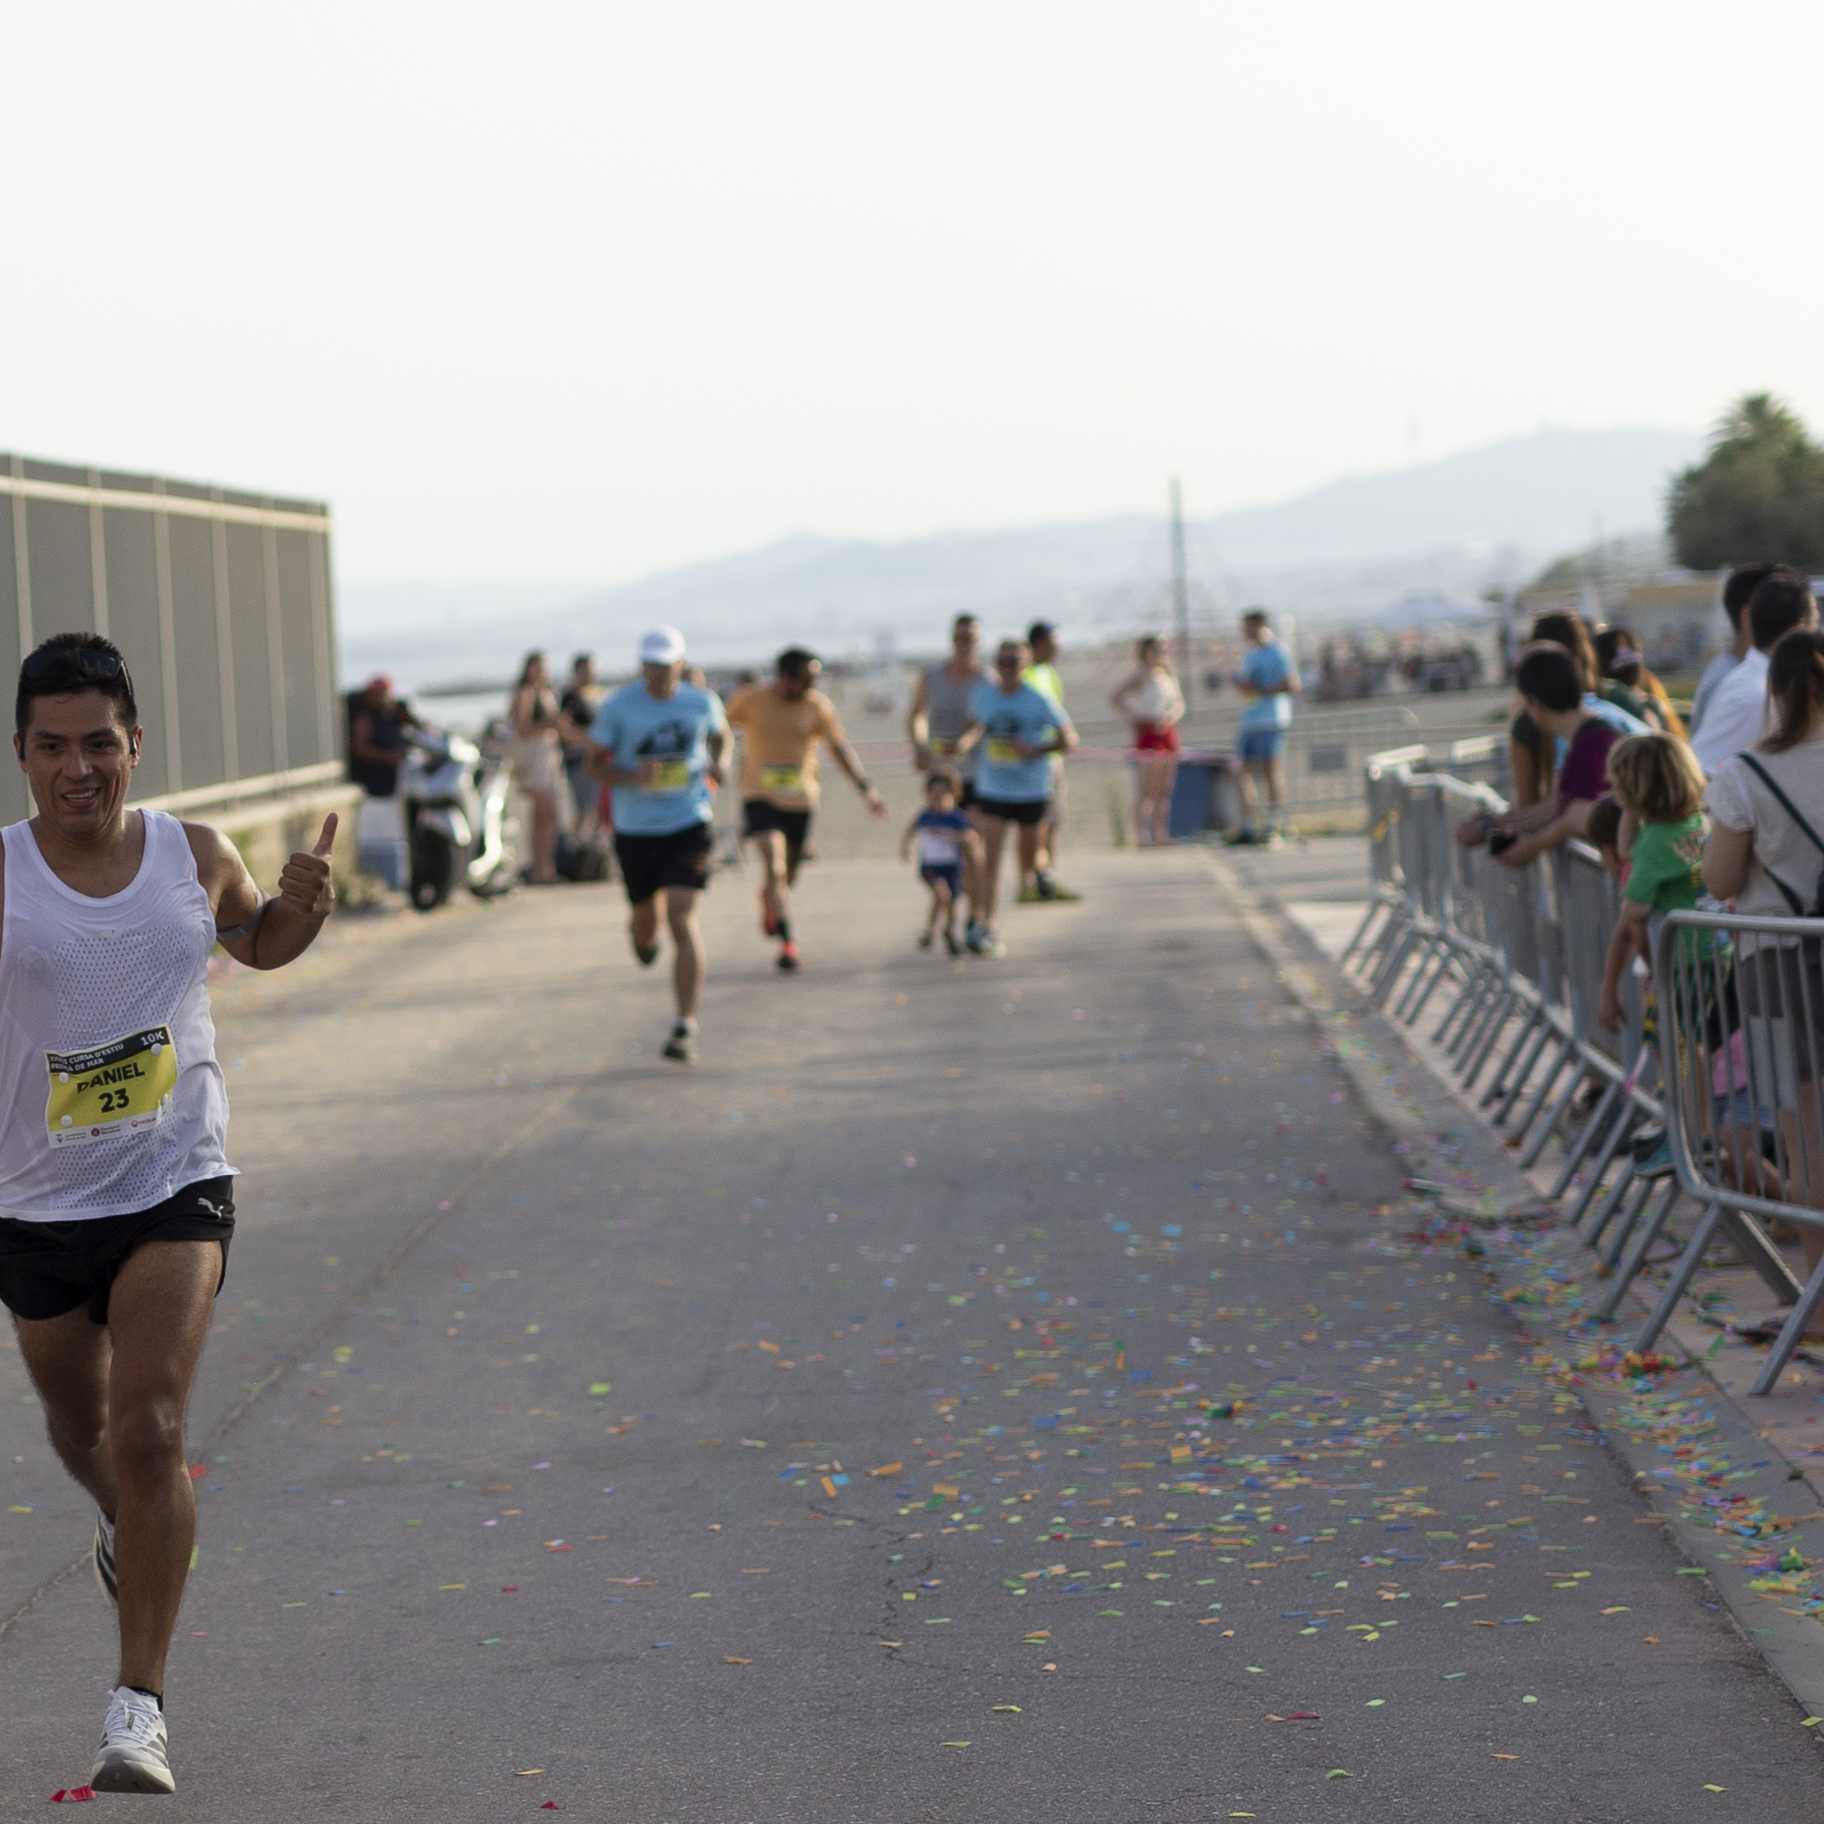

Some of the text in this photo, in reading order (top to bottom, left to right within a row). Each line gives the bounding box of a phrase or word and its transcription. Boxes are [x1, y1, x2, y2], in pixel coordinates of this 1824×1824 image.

[140, 1030, 164, 1046] 10K
[69, 1053, 94, 1064] CURSA
[95, 1043, 124, 1058] D'ESTIU
[74, 1063, 86, 1072] DE
[87, 1058, 105, 1068] MAR
[76, 1062, 146, 1093] DANIEL
[98, 1087, 130, 1113] 23
